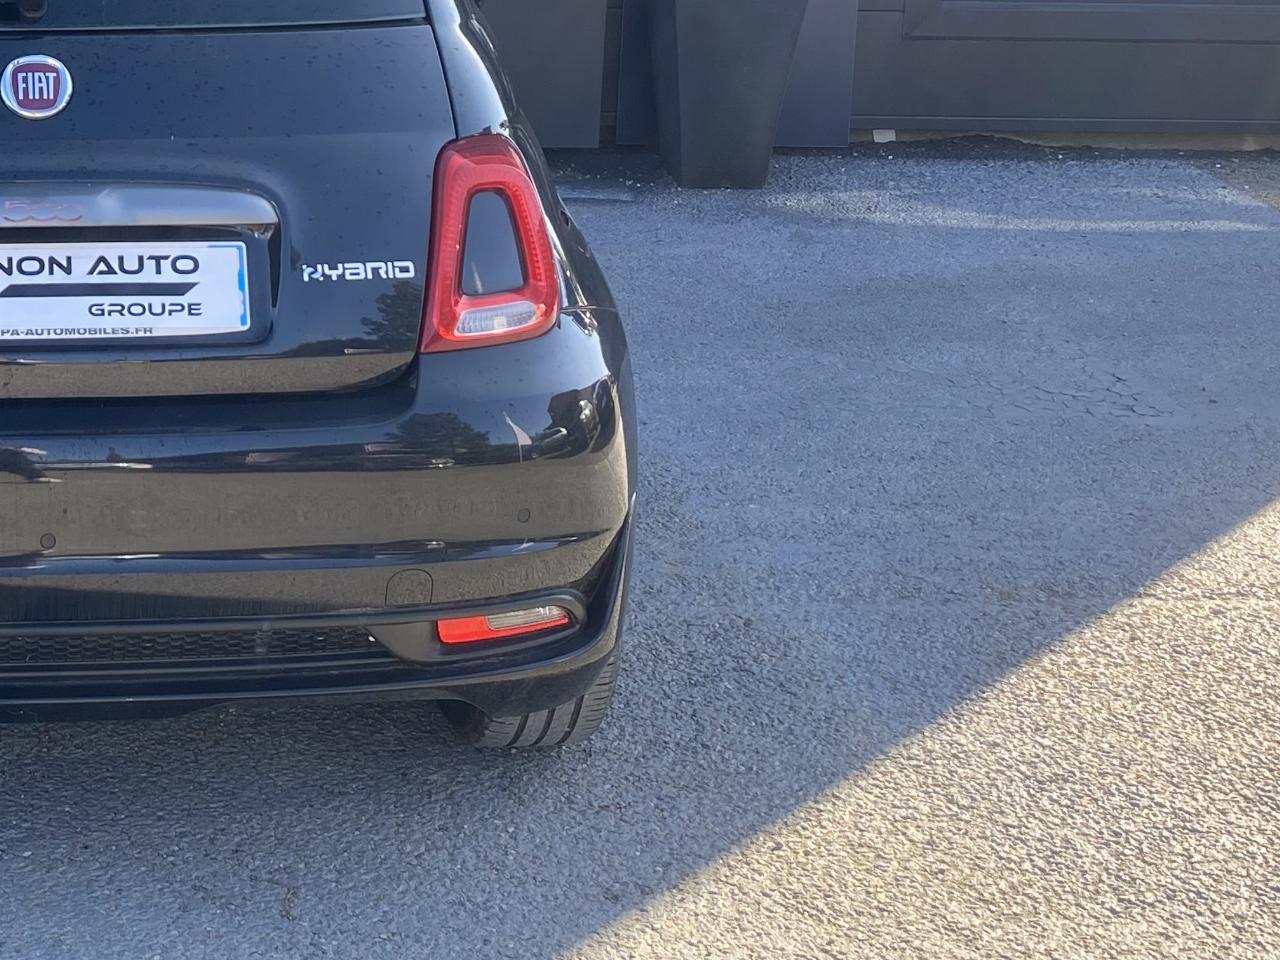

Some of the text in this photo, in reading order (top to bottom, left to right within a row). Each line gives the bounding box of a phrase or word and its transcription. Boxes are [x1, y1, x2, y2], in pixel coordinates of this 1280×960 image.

[17, 72, 57, 100] FIAT
[86, 254, 200, 276] AUTO
[302, 261, 415, 282] HYBRID
[88, 302, 203, 317] GROUPE
